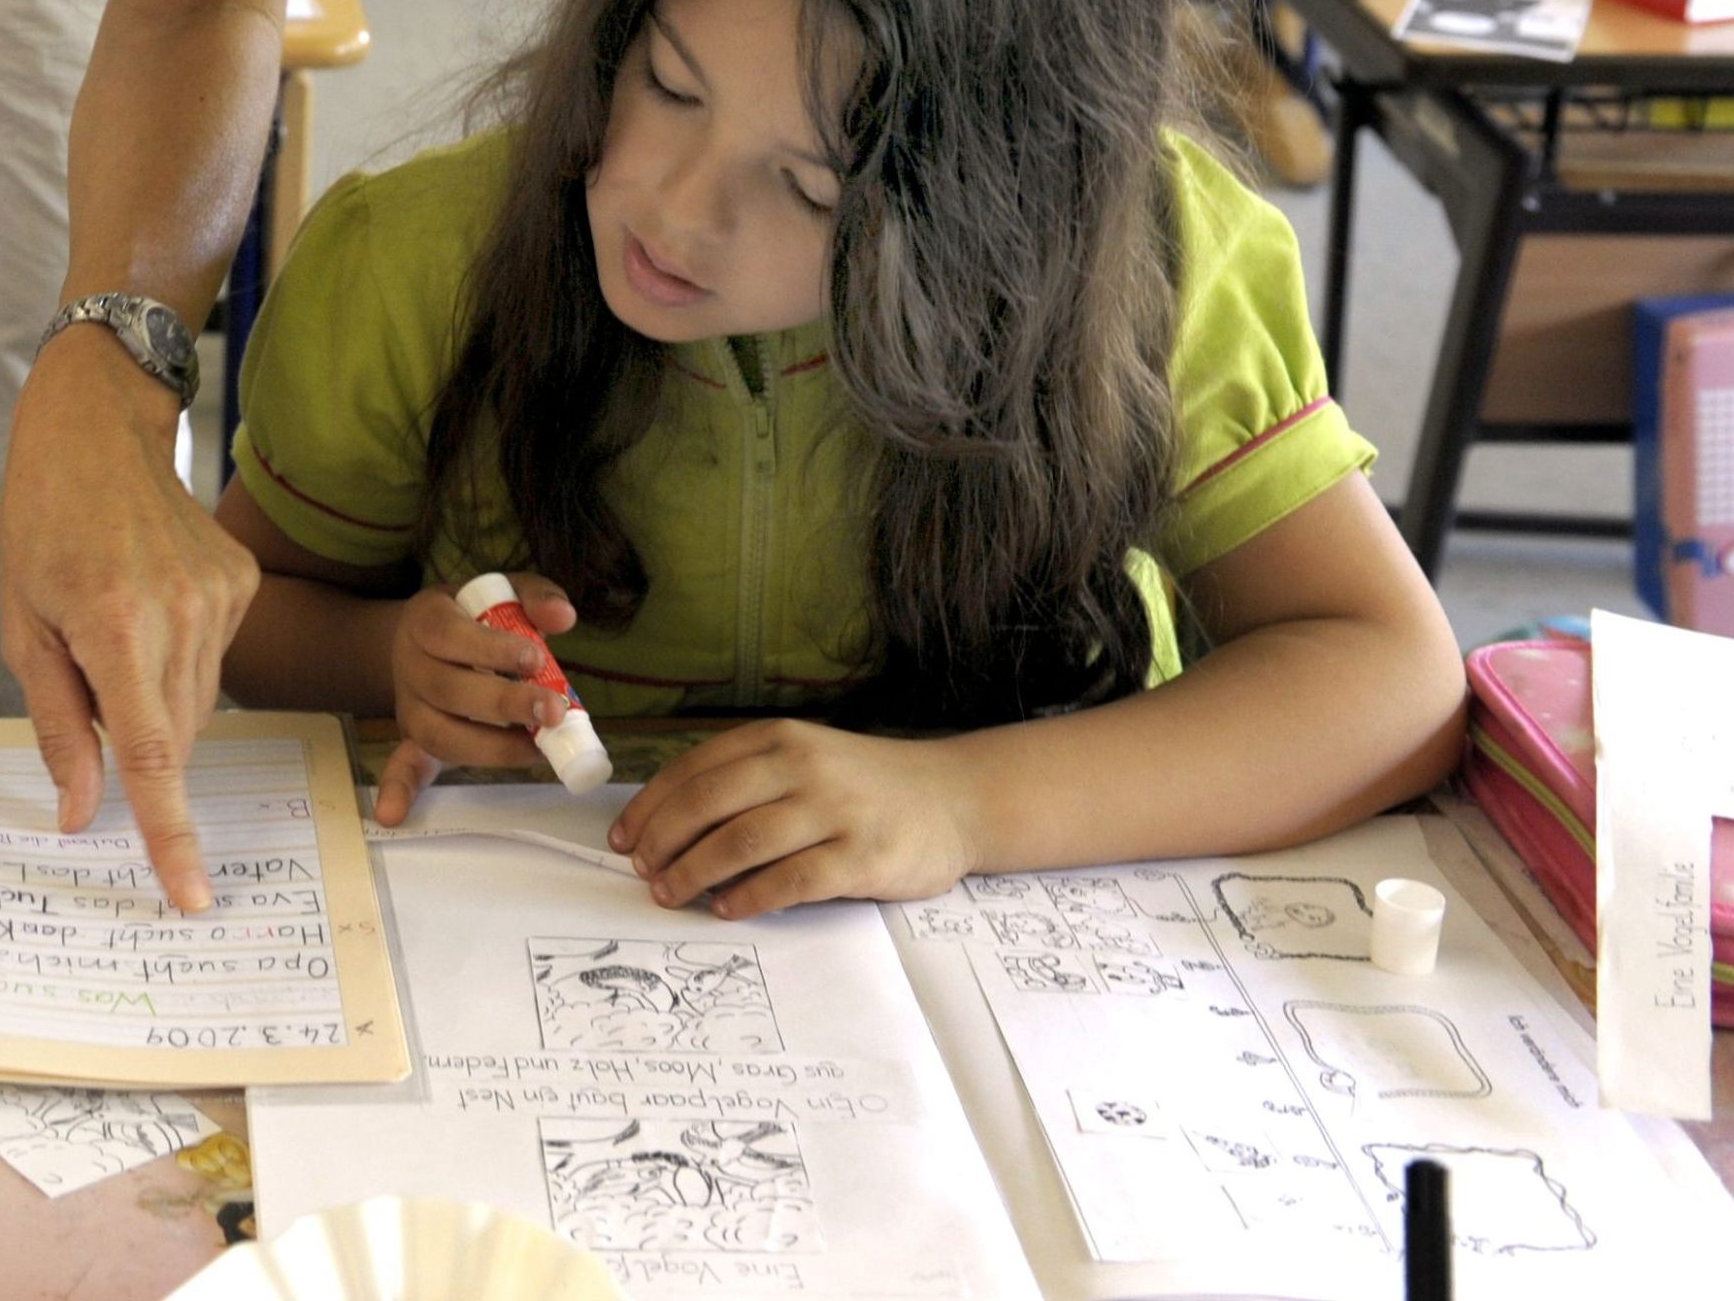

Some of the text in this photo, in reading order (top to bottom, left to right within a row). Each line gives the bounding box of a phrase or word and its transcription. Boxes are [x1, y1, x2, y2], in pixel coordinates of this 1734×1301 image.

[19, 836, 48, 851] die
[36, 864, 91, 887] das
[208, 858, 313, 882] Vater
[73, 895, 135, 920] das
[153, 895, 232, 919] sht
[251, 890, 320, 915] Eva
[101, 922, 193, 951] sucht
[210, 922, 323, 945] Harro
[134, 953, 238, 984] sucht
[257, 953, 329, 980] Opa
[1653, 965, 1697, 1010] Eine
[78, 988, 157, 1017] Was
[513, 1055, 560, 1083] und
[570, 1058, 633, 1083] Holz
[803, 1063, 846, 1084] aus
[457, 1087, 857, 1120] Ein Vogelpaar baut ein Nest
[734, 1261, 804, 1289] Eine
